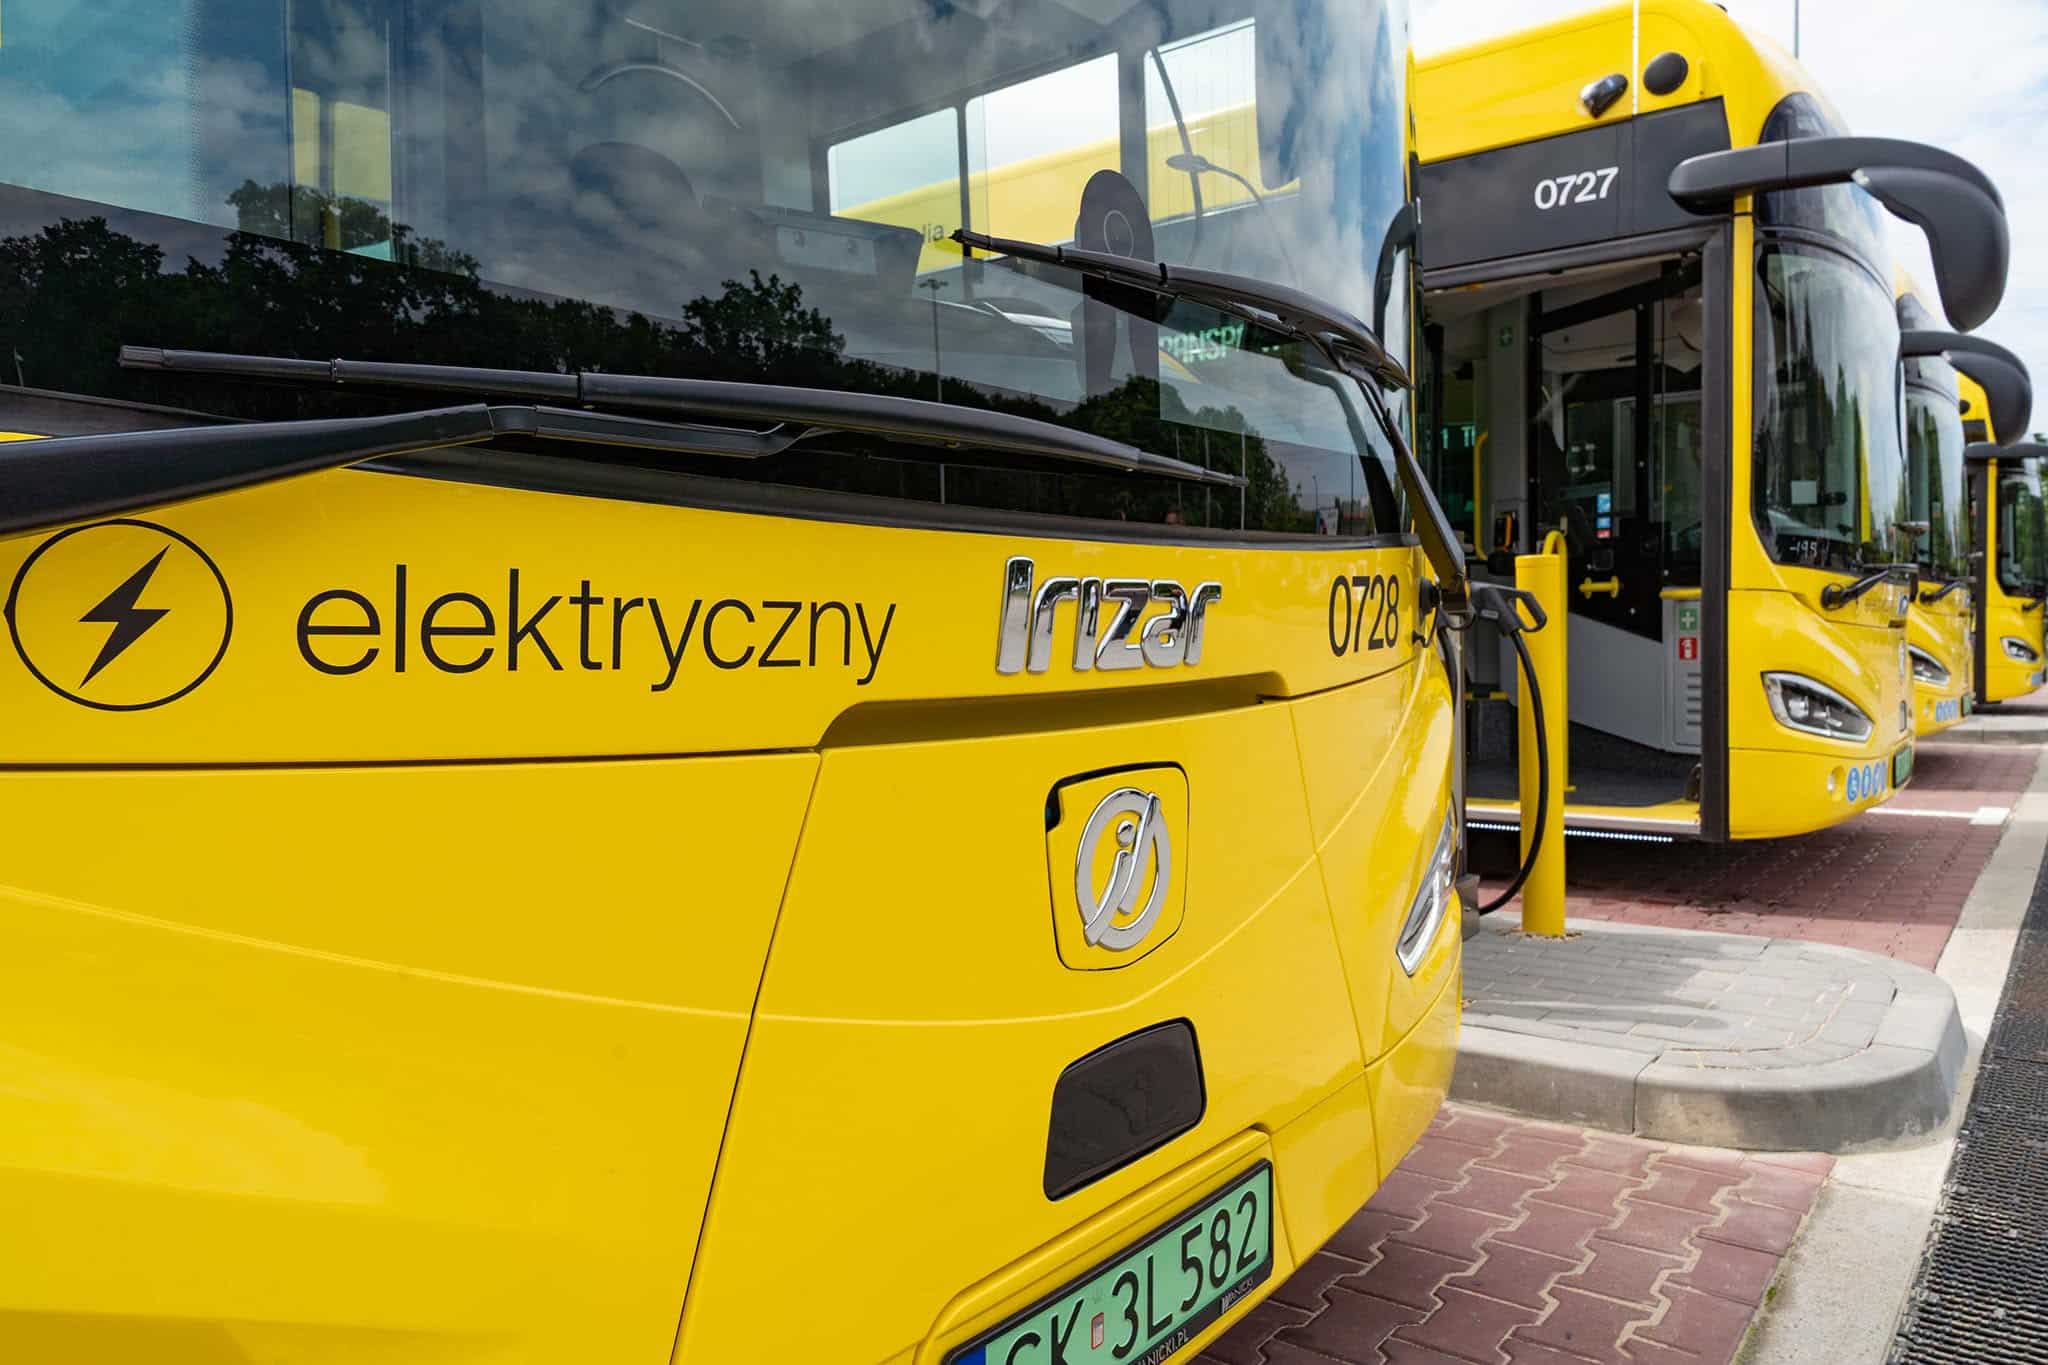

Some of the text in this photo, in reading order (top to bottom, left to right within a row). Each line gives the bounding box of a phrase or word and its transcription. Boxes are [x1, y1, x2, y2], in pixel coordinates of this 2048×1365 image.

[1534, 166, 1619, 210] 0727
[297, 564, 897, 692] elektryczny
[996, 555, 1223, 675] Irizar
[1328, 574, 1400, 658] 0728
[1111, 1190, 1258, 1361] 3L582
